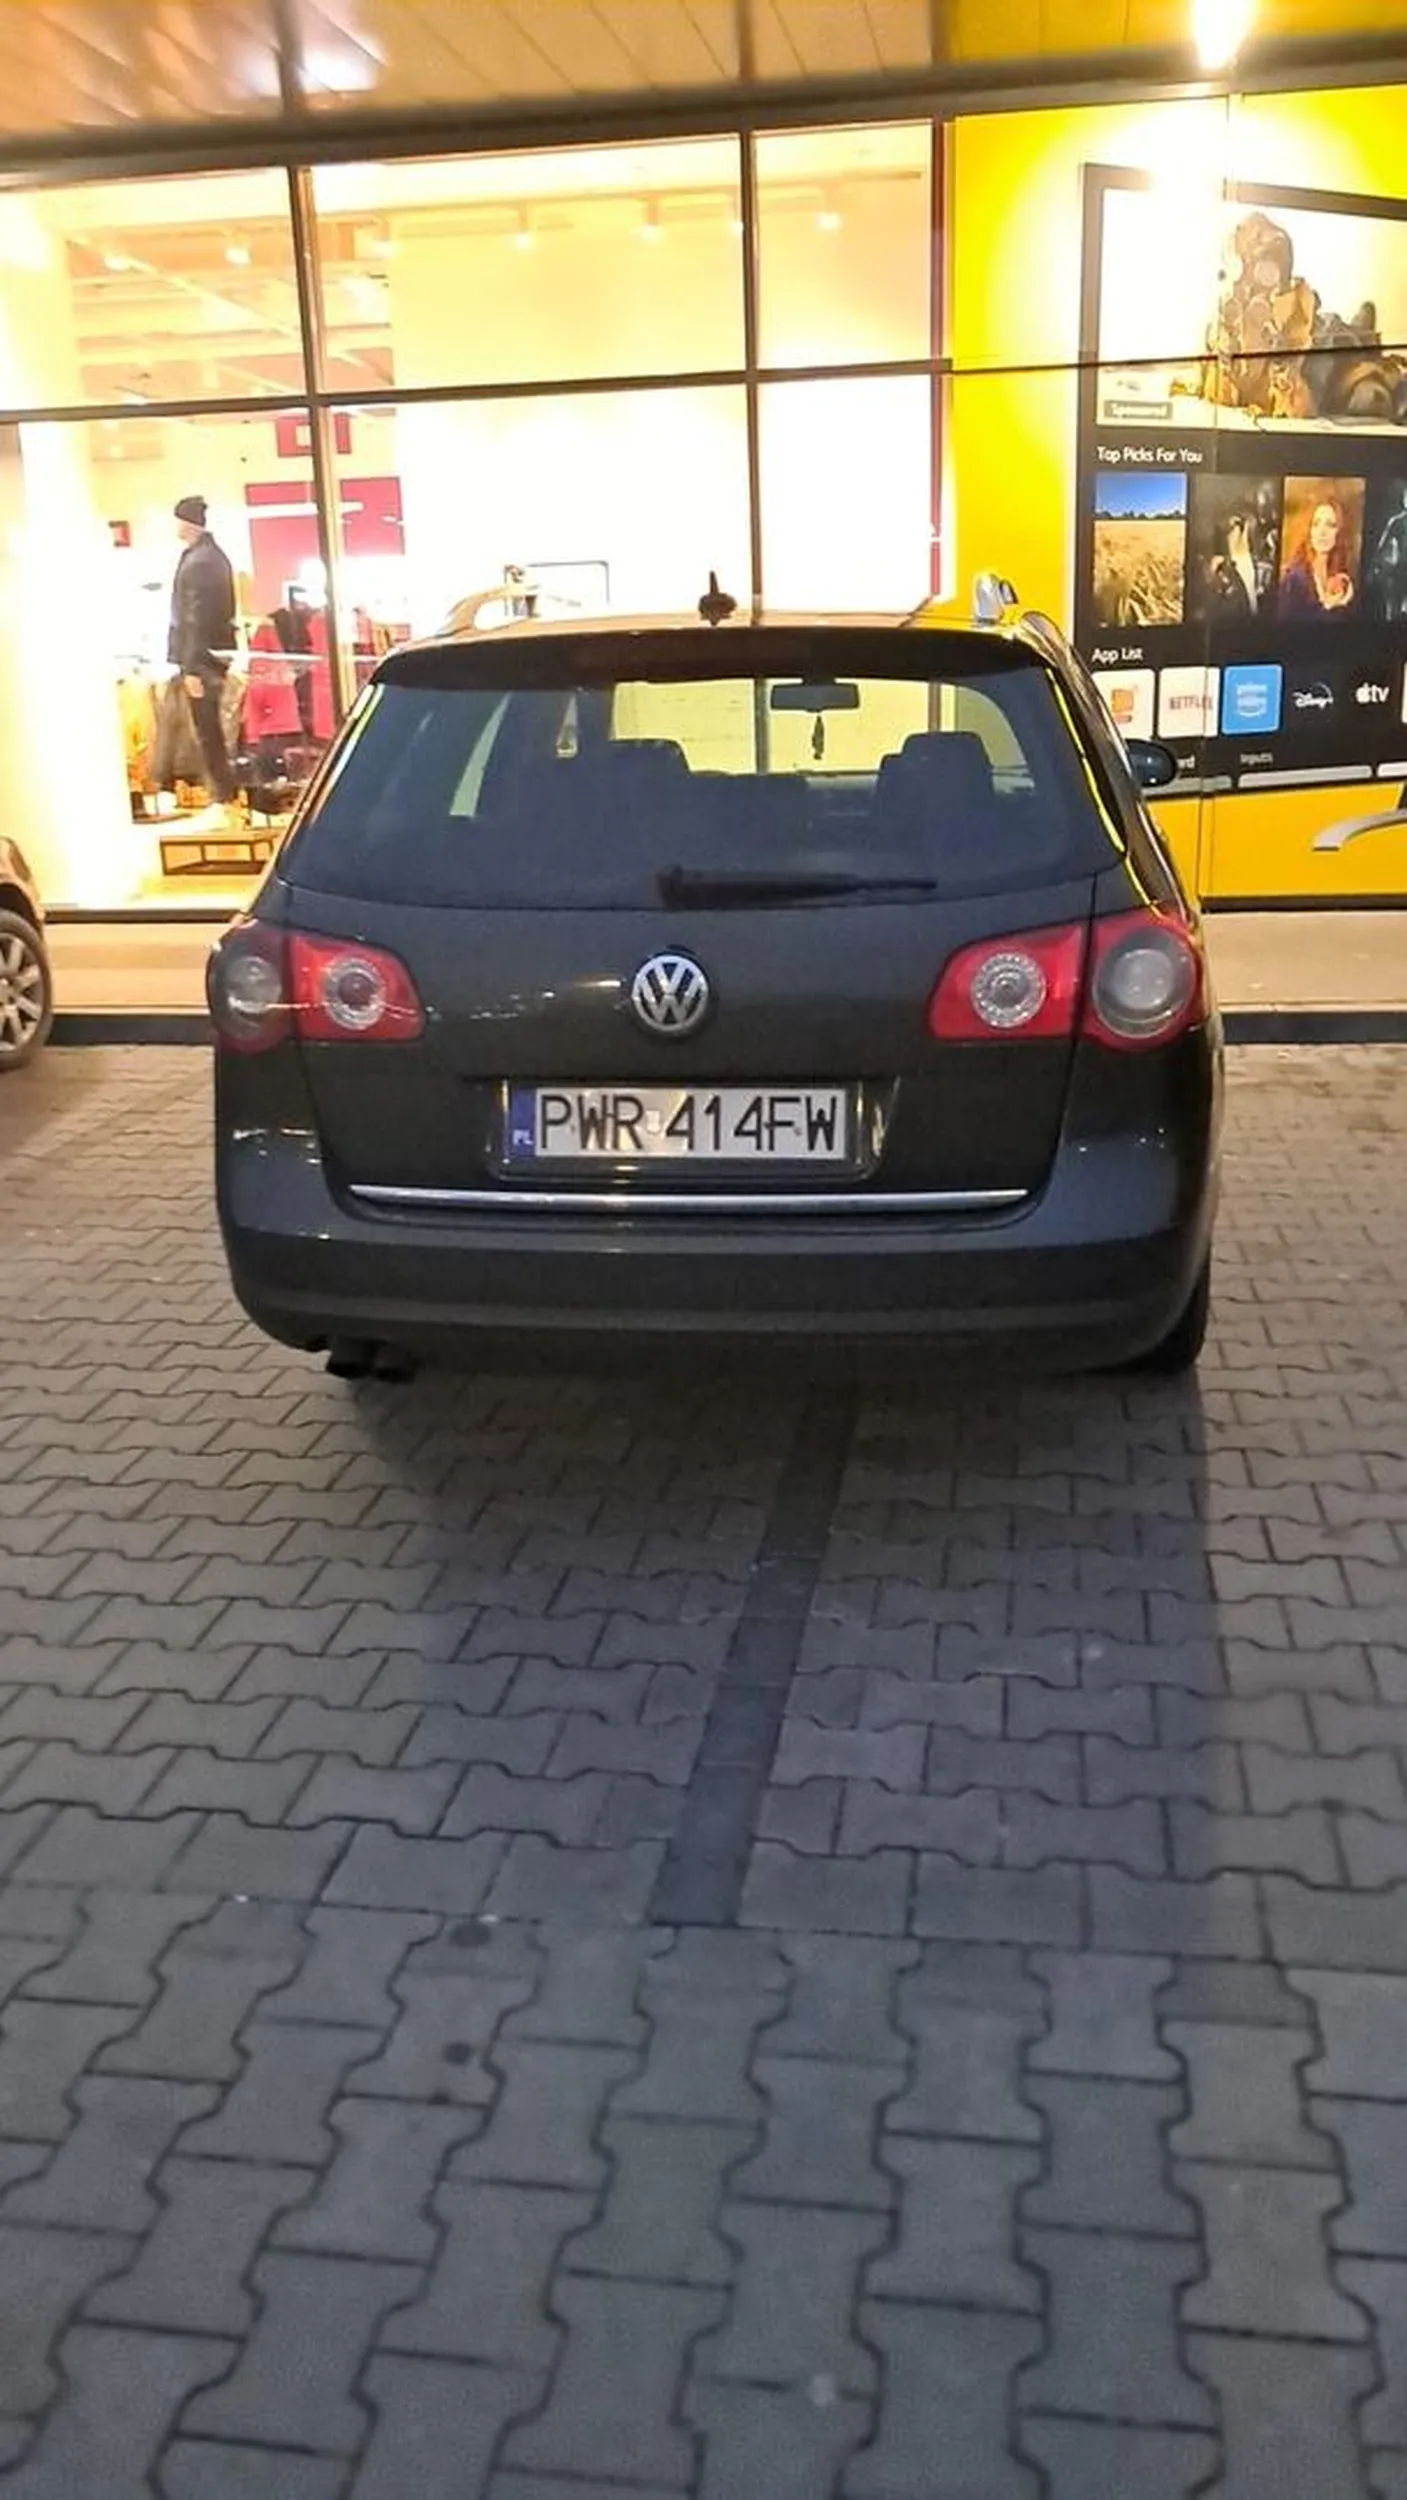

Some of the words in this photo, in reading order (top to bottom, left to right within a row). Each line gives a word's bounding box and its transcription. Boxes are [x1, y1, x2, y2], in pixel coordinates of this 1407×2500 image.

[1097, 447, 1121, 464] Top
[1123, 446, 1154, 462] Picks
[1156, 447, 1177, 462] For
[1179, 448, 1203, 463] You
[1091, 648, 1119, 664] App
[1121, 647, 1143, 660] List
[541, 1094, 644, 1150] PWR
[666, 1096, 838, 1151] 414FW
[513, 1129, 534, 1146] PL
